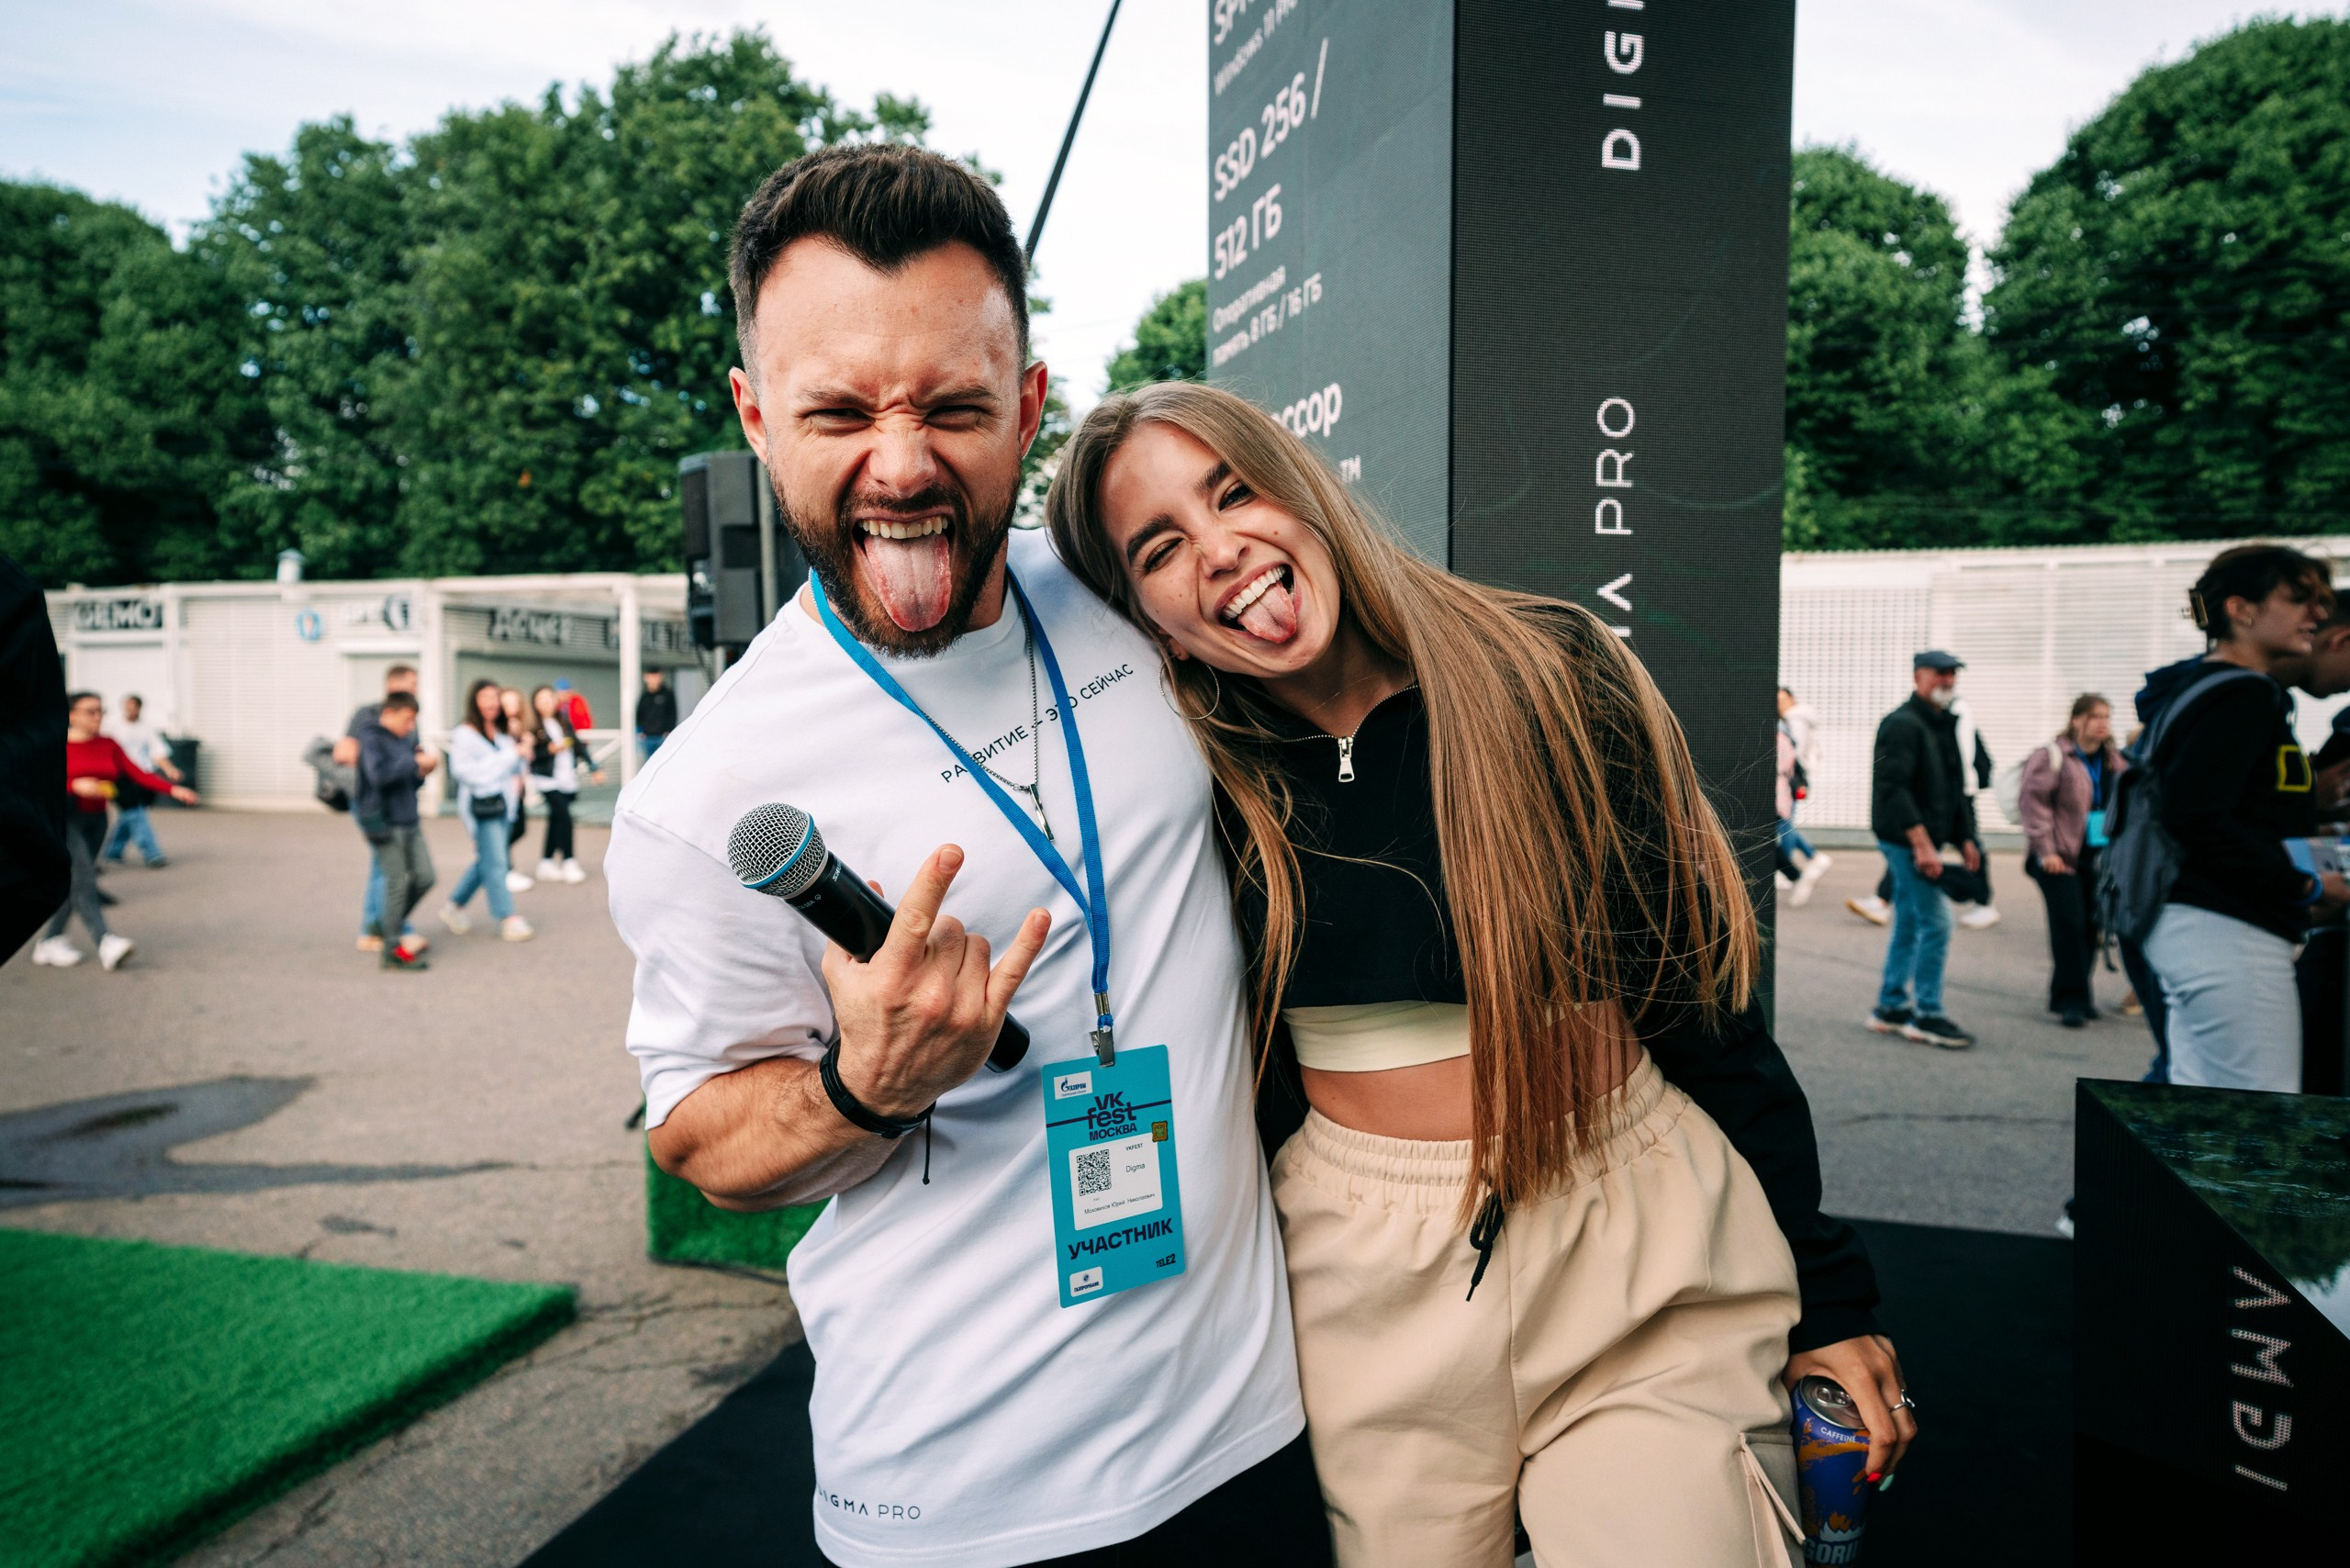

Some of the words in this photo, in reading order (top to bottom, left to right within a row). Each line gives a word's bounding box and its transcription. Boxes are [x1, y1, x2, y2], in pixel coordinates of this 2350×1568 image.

[1601, 0, 1645, 172] DIG
[1214, 127, 1257, 201] SSD
[1261, 72, 1306, 159] 256
[1311, 37, 1328, 119] /
[1214, 216, 1248, 281] 512
[1253, 183, 1282, 251] ГБ
[1303, 272, 1322, 308] ГБ
[1595, 396, 1636, 535] PRO
[940, 725, 1029, 783] РАВИТИЕ
[1045, 696, 1079, 722] ЭО
[1080, 664, 1134, 700] СЕЙЧАС
[1087, 1102, 1136, 1129] fest
[1094, 1092, 1125, 1111] VK
[1089, 1123, 1137, 1141] МОСКВА
[1125, 1163, 1146, 1173] Digma
[1068, 1217, 1173, 1260] УЧАСТНИК
[1156, 1253, 1176, 1268] TELE2
[1820, 1427, 1858, 1444] CAFFEINE
[878, 1504, 921, 1520] PRO
